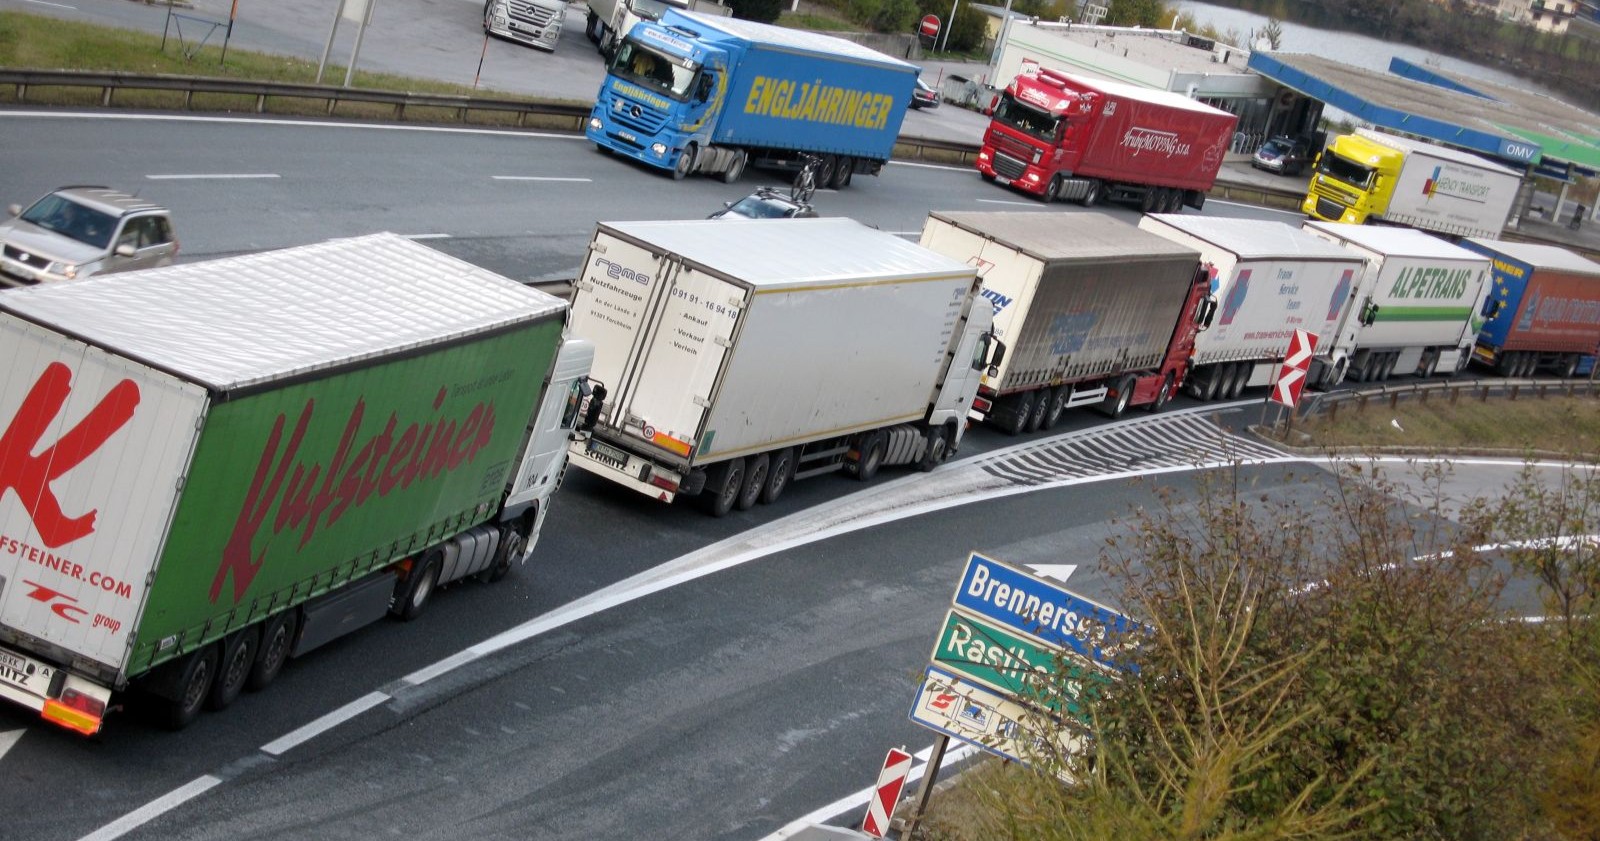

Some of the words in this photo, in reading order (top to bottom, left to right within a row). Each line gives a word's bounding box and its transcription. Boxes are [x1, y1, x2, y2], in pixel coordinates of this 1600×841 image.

[743, 75, 893, 131] ENGLJÄHRINGER
[1506, 144, 1534, 159] OMV
[590, 276, 643, 301] Nutzfahrzeuge
[1388, 266, 1472, 300] ALPETRANS
[683, 312, 708, 326] Ankauf
[677, 328, 705, 343] Verkauf
[673, 340, 697, 355] Verleih
[584, 447, 627, 472] SCHMITZ
[208, 384, 496, 604] Kufsteiner
[92, 613, 121, 634] group
[42, 668, 50, 677] A
